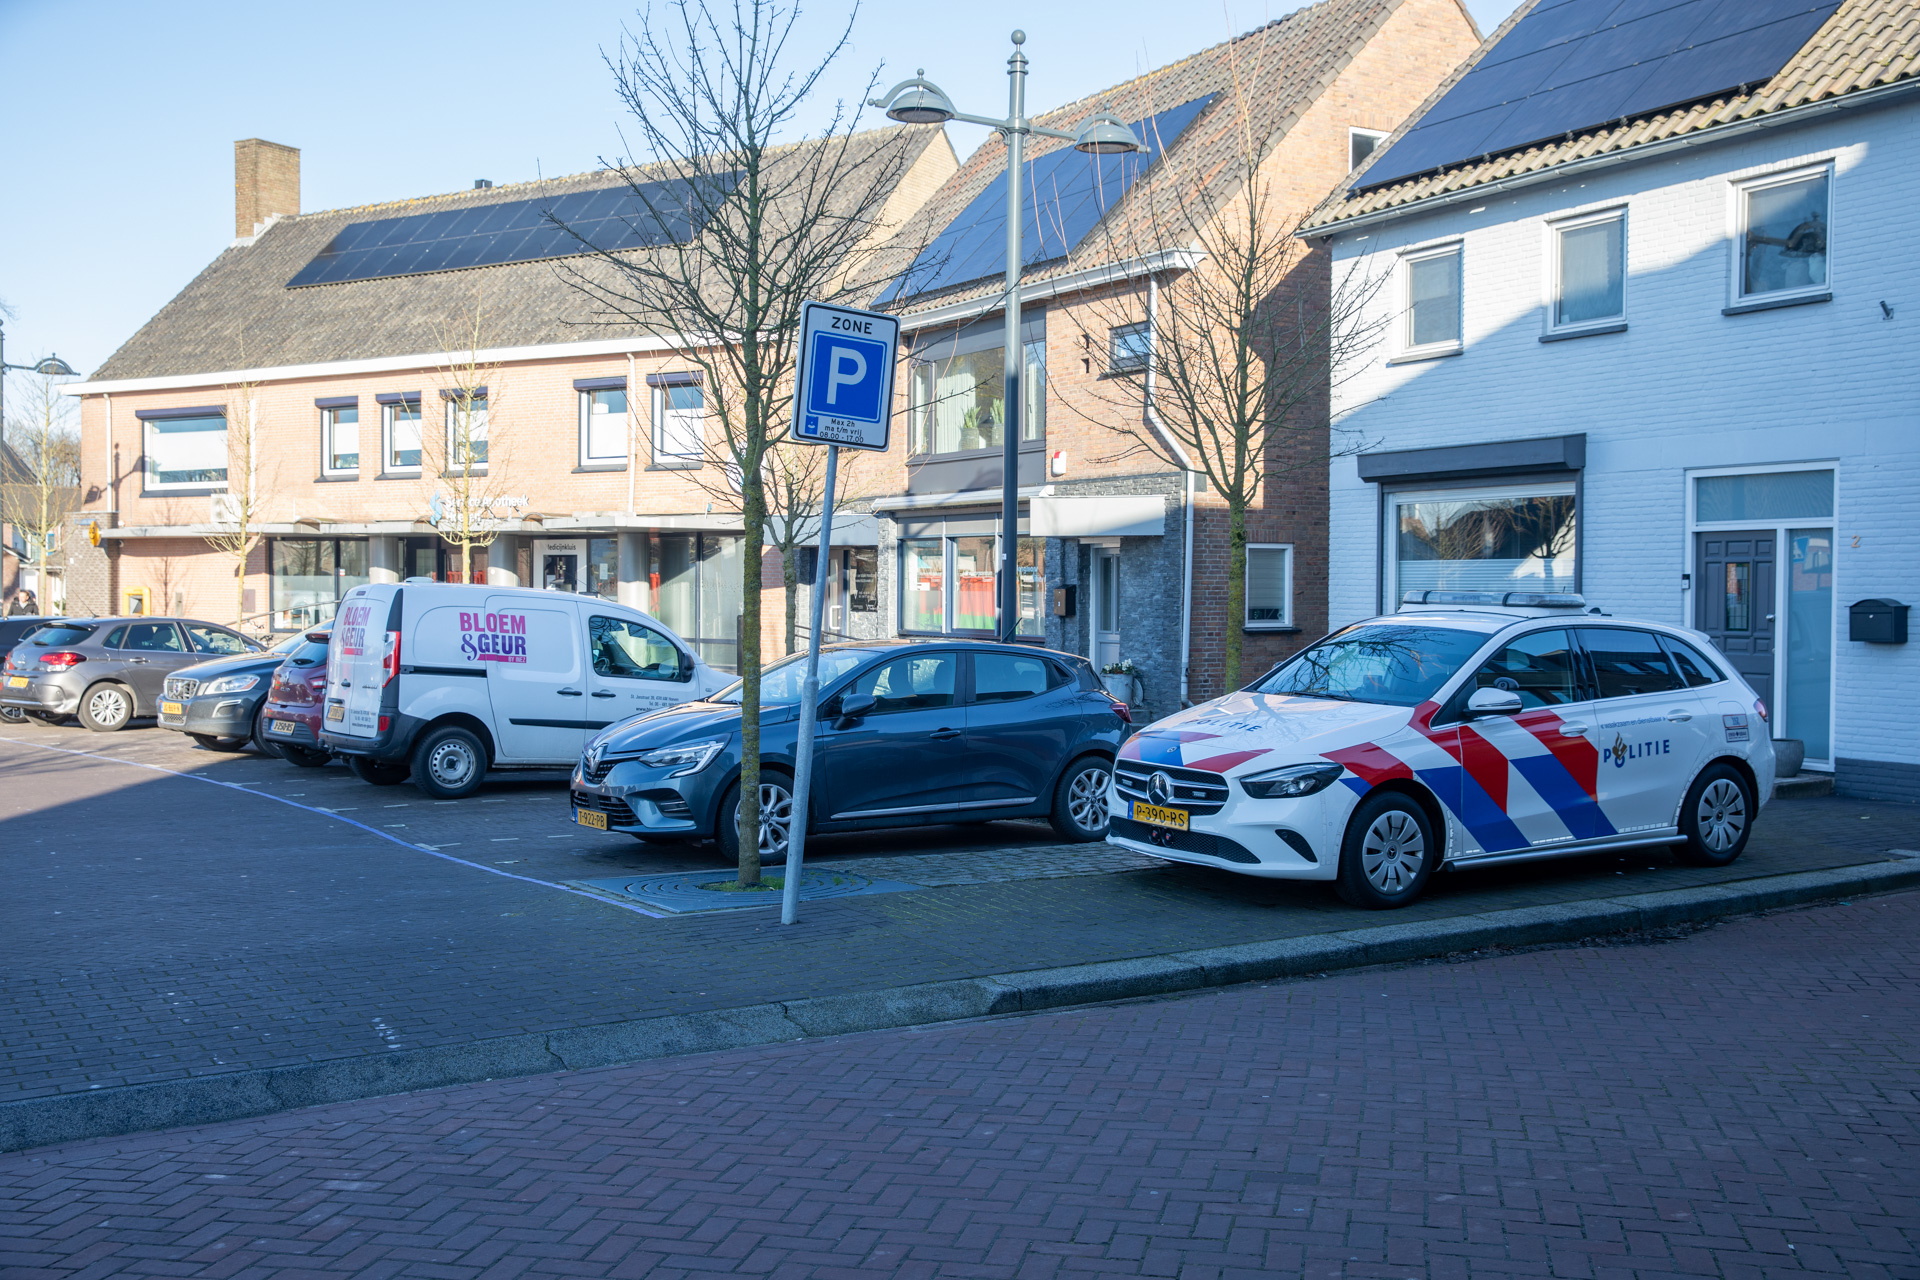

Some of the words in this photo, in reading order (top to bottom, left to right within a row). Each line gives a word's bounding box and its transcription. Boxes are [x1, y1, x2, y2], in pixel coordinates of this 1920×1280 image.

[831, 316, 873, 335] ZONE
[826, 345, 868, 405] P
[831, 418, 845, 426] Max
[820, 431, 839, 439] 08.00
[846, 435, 864, 443] 17.00
[850, 429, 862, 437] vrij
[482, 494, 529, 508] Apotheek
[1851, 535, 1861, 548] 2
[344, 606, 372, 626] BLOEM
[459, 612, 526, 635] BLOEM
[1184, 719, 1263, 732] POLITIE
[1603, 739, 1670, 768] POLITIE
[579, 810, 605, 827] T-922-PB
[1136, 804, 1185, 827] P-390-RS
